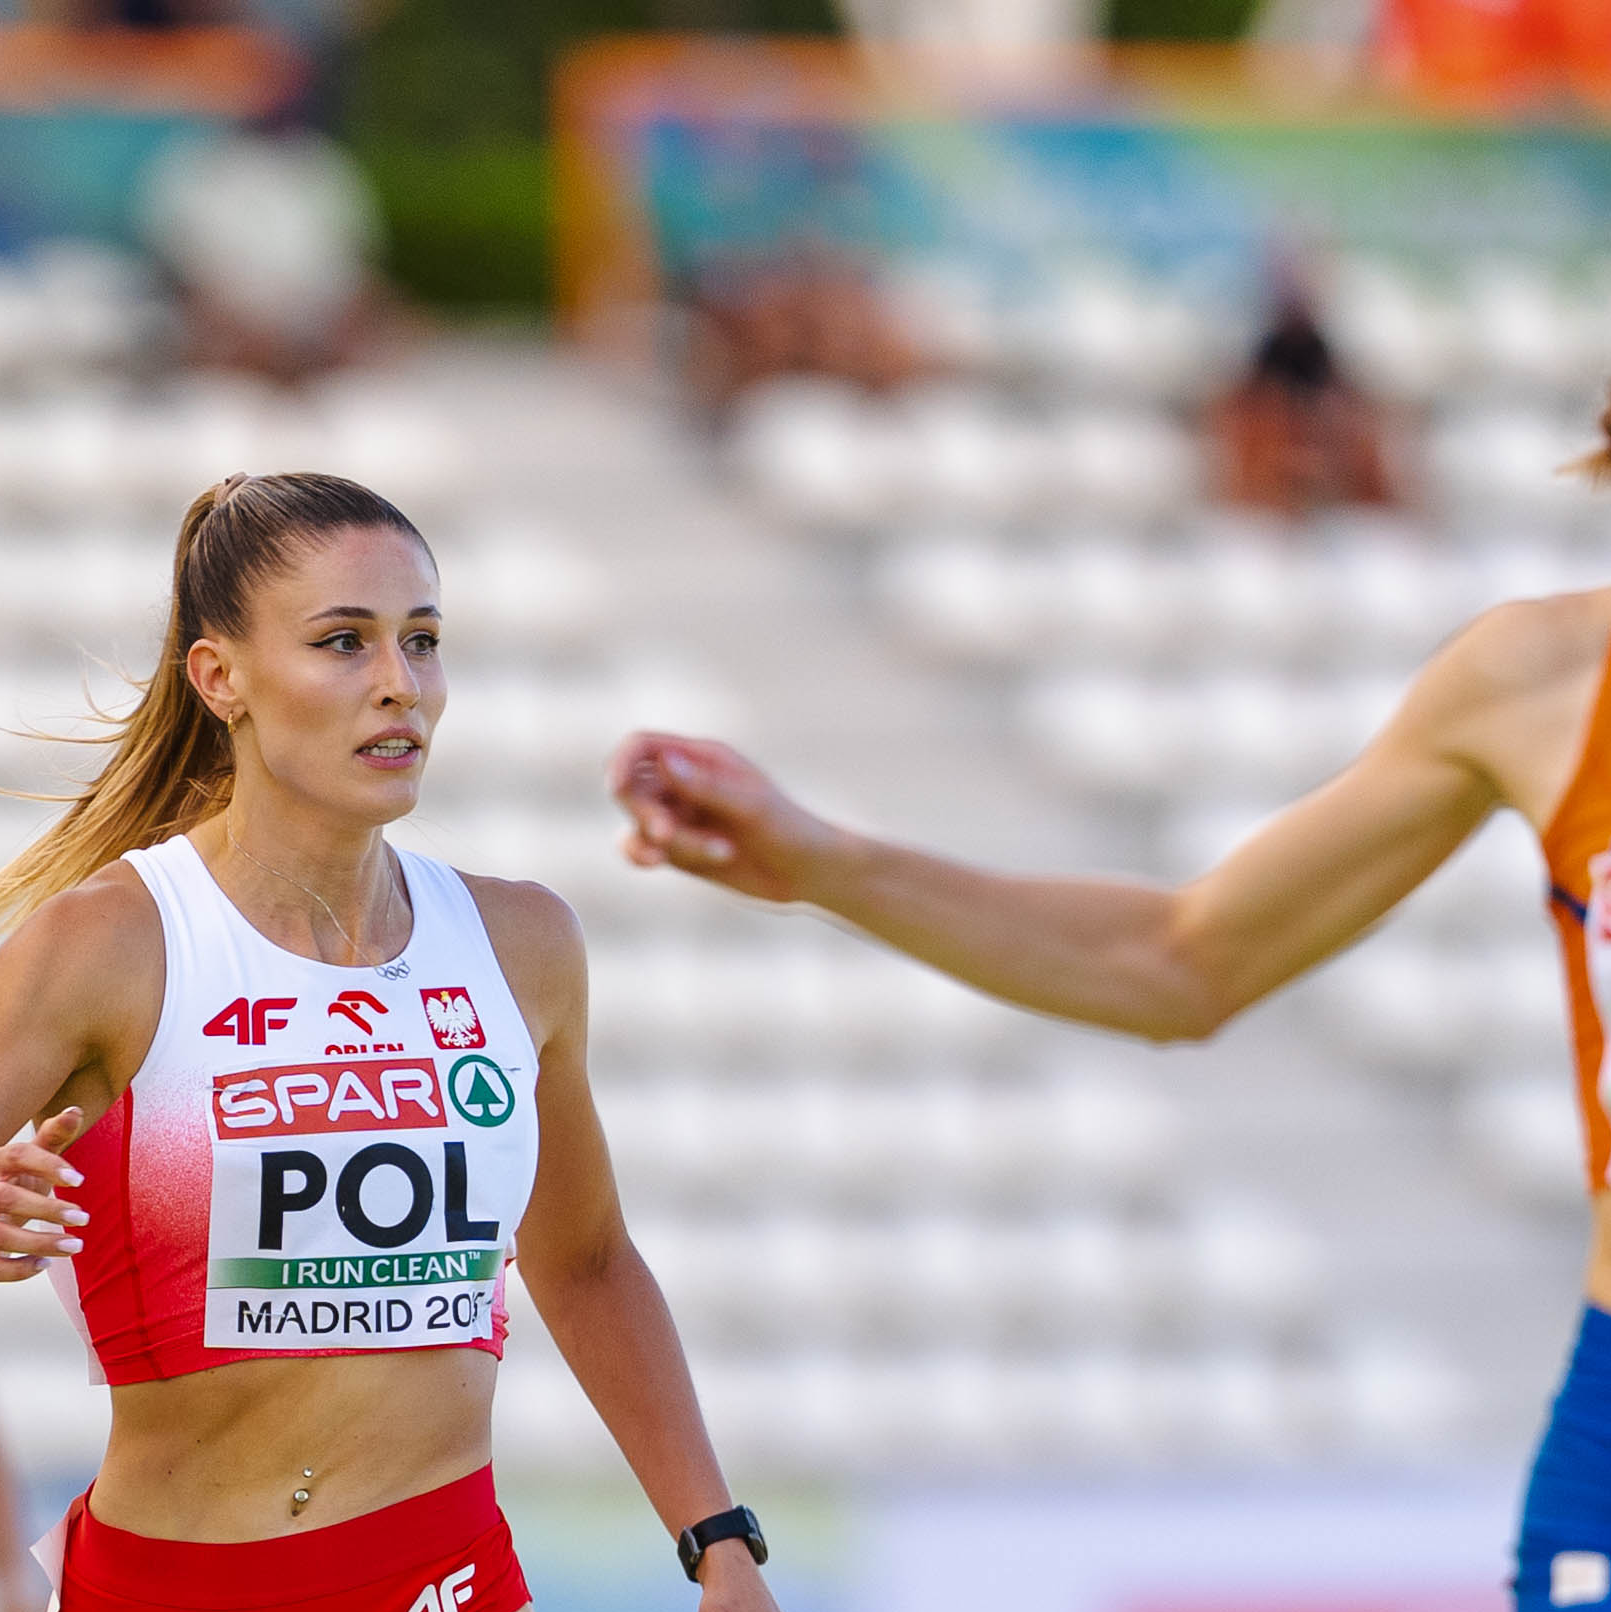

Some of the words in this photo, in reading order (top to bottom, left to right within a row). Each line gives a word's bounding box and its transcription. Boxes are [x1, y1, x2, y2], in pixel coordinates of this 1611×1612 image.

[202, 996, 298, 1046] 4F
[218, 1066, 440, 1130] SPAR
[257, 1141, 500, 1250] POL
[281, 1262, 289, 1285] I
[297, 1259, 365, 1285] RUN
[237, 1299, 413, 1334] MADRID
